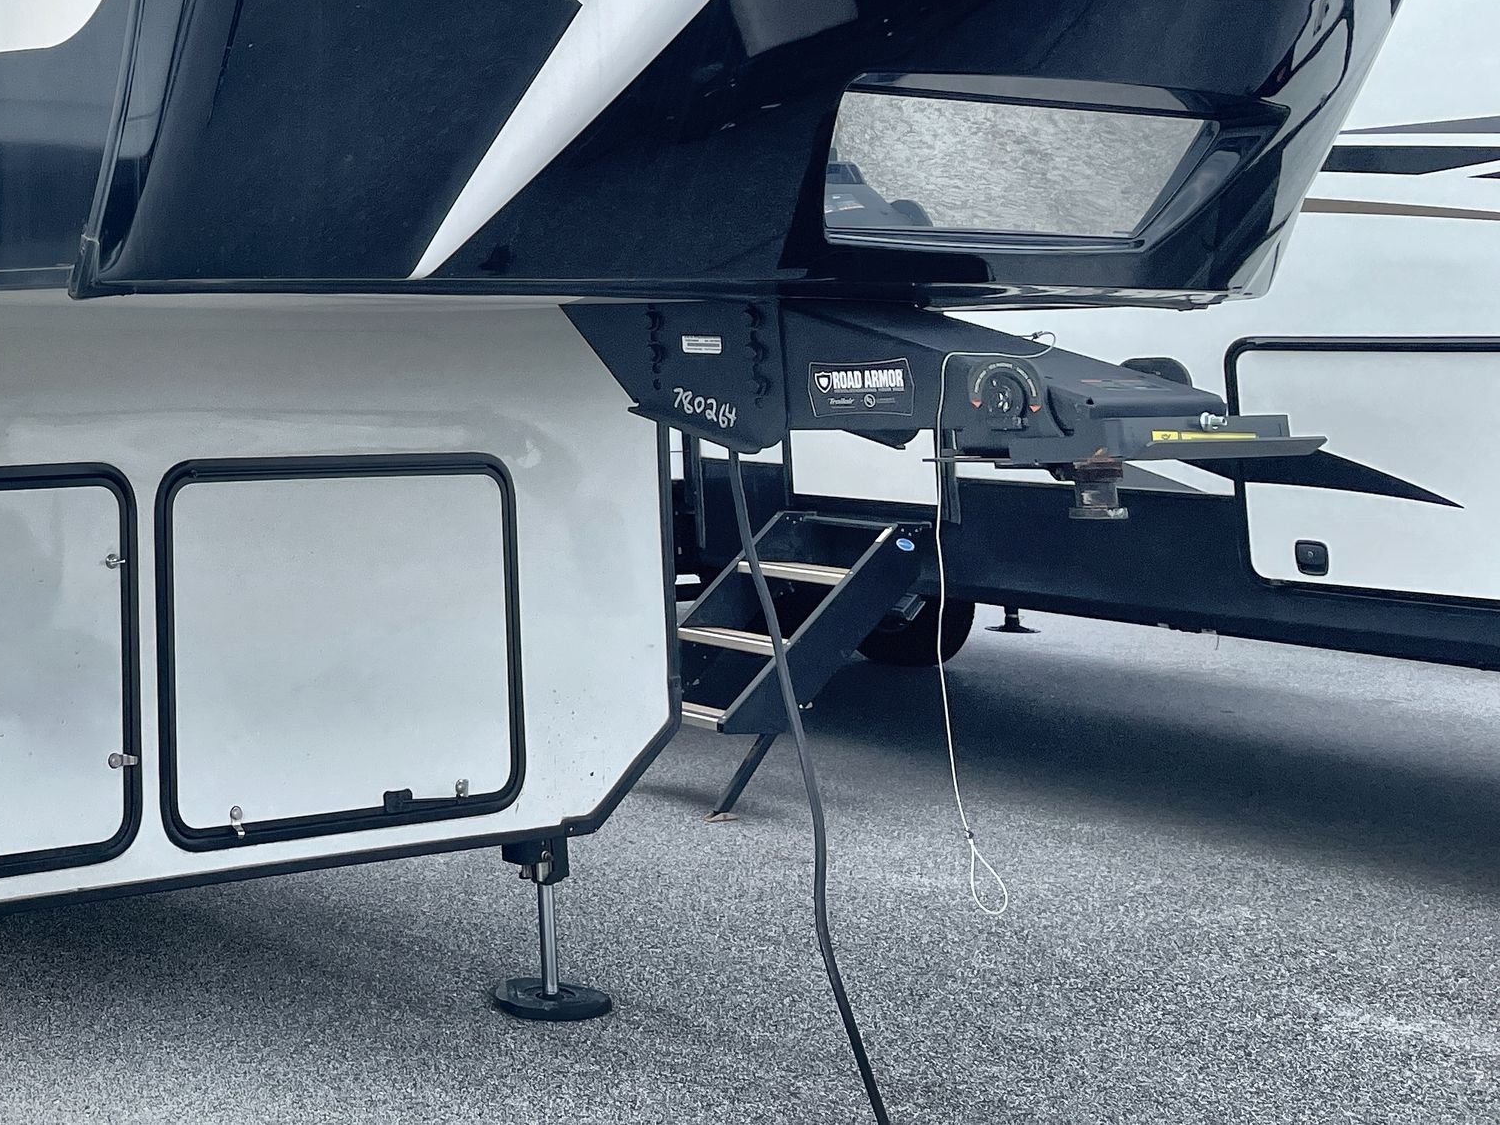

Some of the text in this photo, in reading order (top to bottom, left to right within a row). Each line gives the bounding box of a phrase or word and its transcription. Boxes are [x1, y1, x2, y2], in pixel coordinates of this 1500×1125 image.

[832, 369, 905, 389] ROAD ARMOR
[673, 387, 737, 429] 780264
